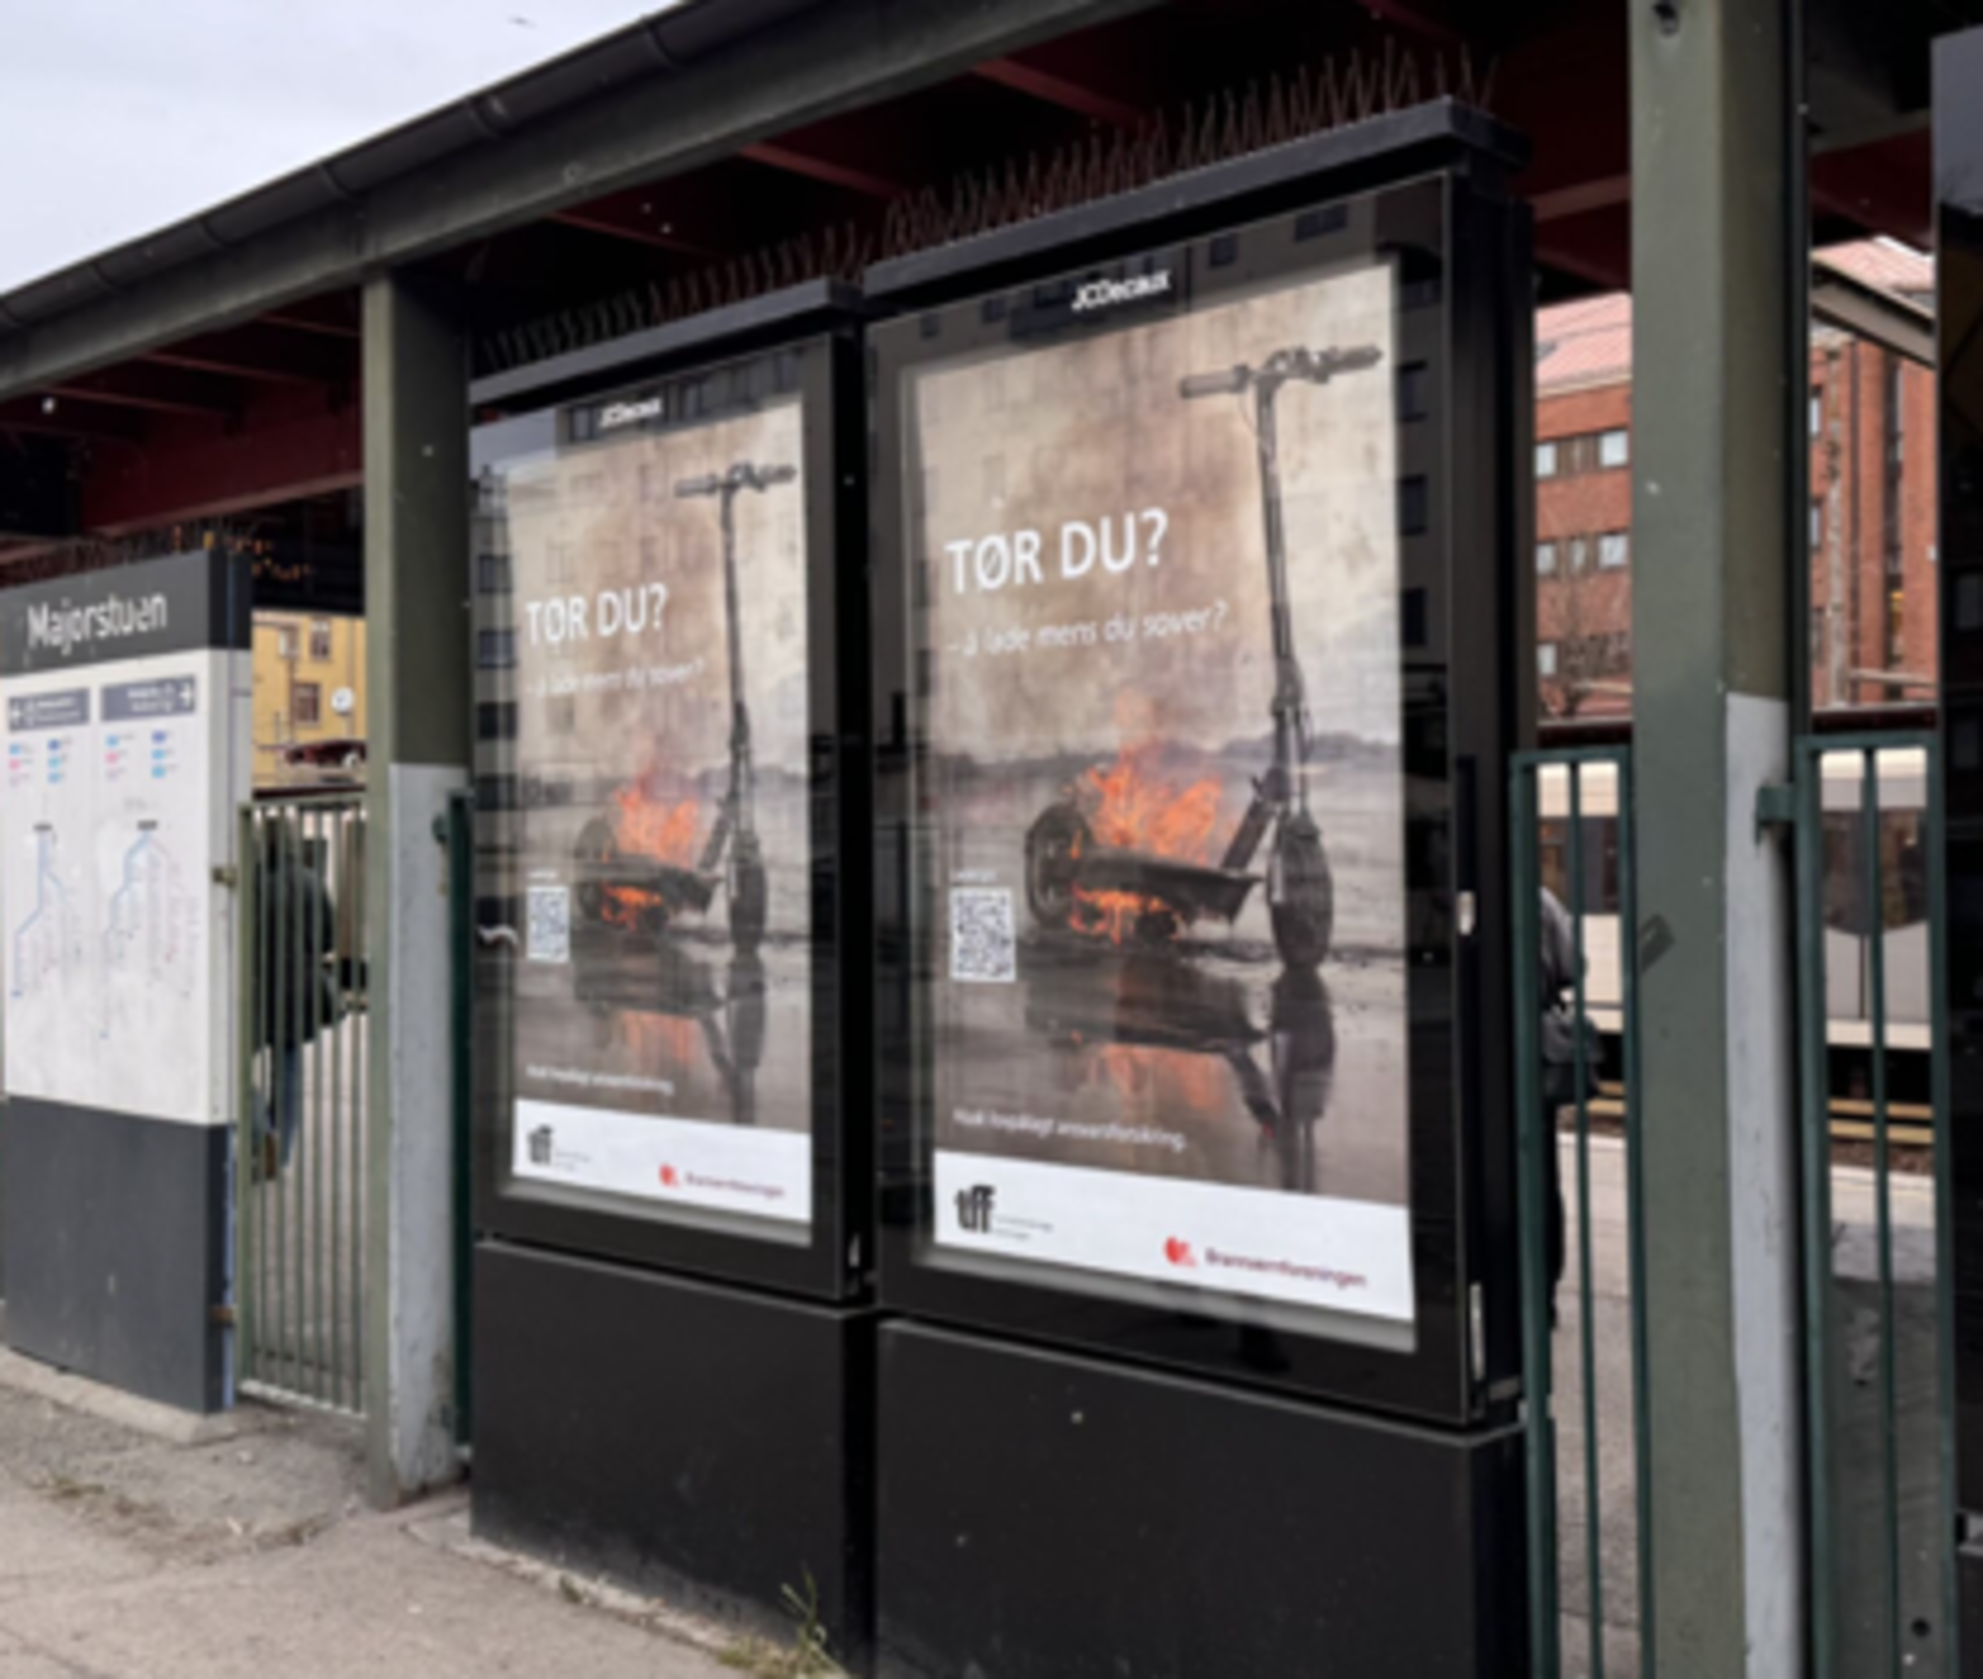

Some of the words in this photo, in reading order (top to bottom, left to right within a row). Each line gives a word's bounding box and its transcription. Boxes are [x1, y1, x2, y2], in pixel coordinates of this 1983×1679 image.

[945, 530, 1043, 594] TØR
[1060, 507, 1169, 578] DU?
[27, 592, 167, 656] Majorstuen
[597, 583, 669, 638] DU?
